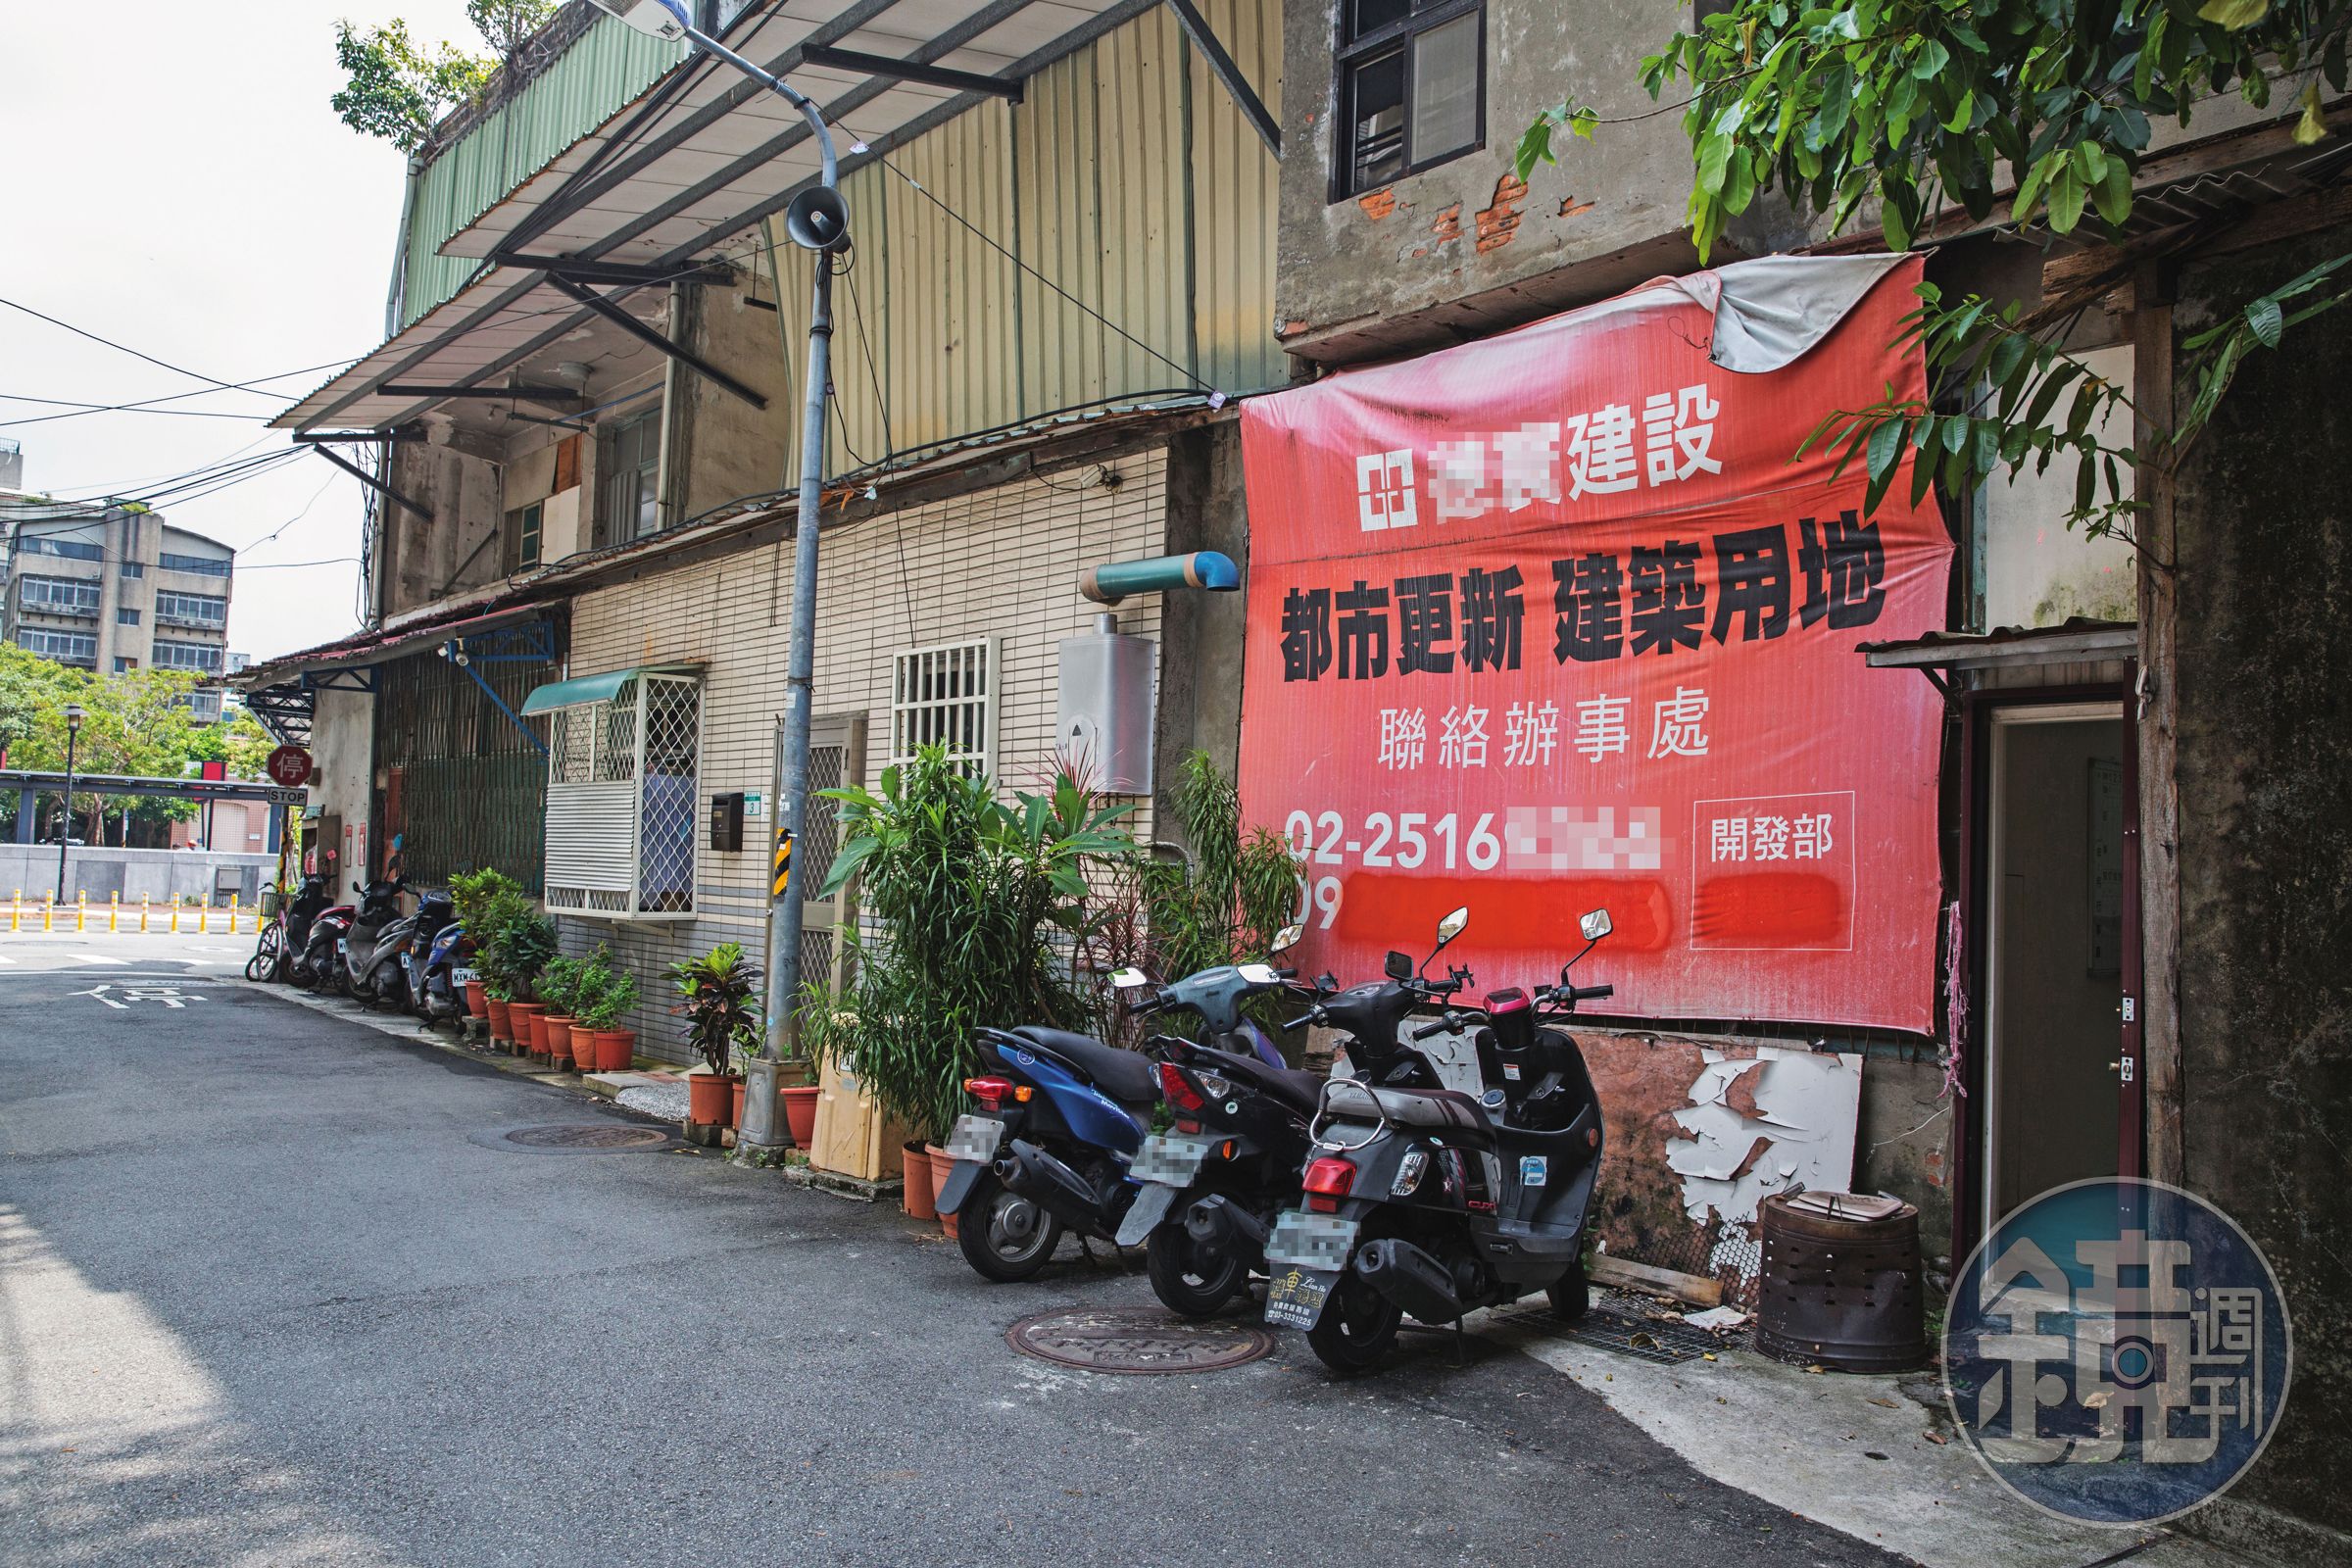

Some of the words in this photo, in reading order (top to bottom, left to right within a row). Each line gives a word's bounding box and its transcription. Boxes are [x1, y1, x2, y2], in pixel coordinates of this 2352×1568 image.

[1280, 564, 1526, 682] 都市更新
[1550, 510, 1886, 665] 建築用地
[1377, 687, 1710, 771] 聯絡辦事處
[276, 754, 304, 779] 停
[270, 791, 305, 802] STOP
[749, 803, 755, 813] 3
[1285, 809, 1660, 871] 02-2516
[1711, 812, 1834, 862] 開發部
[66, 985, 209, 1008] 停
